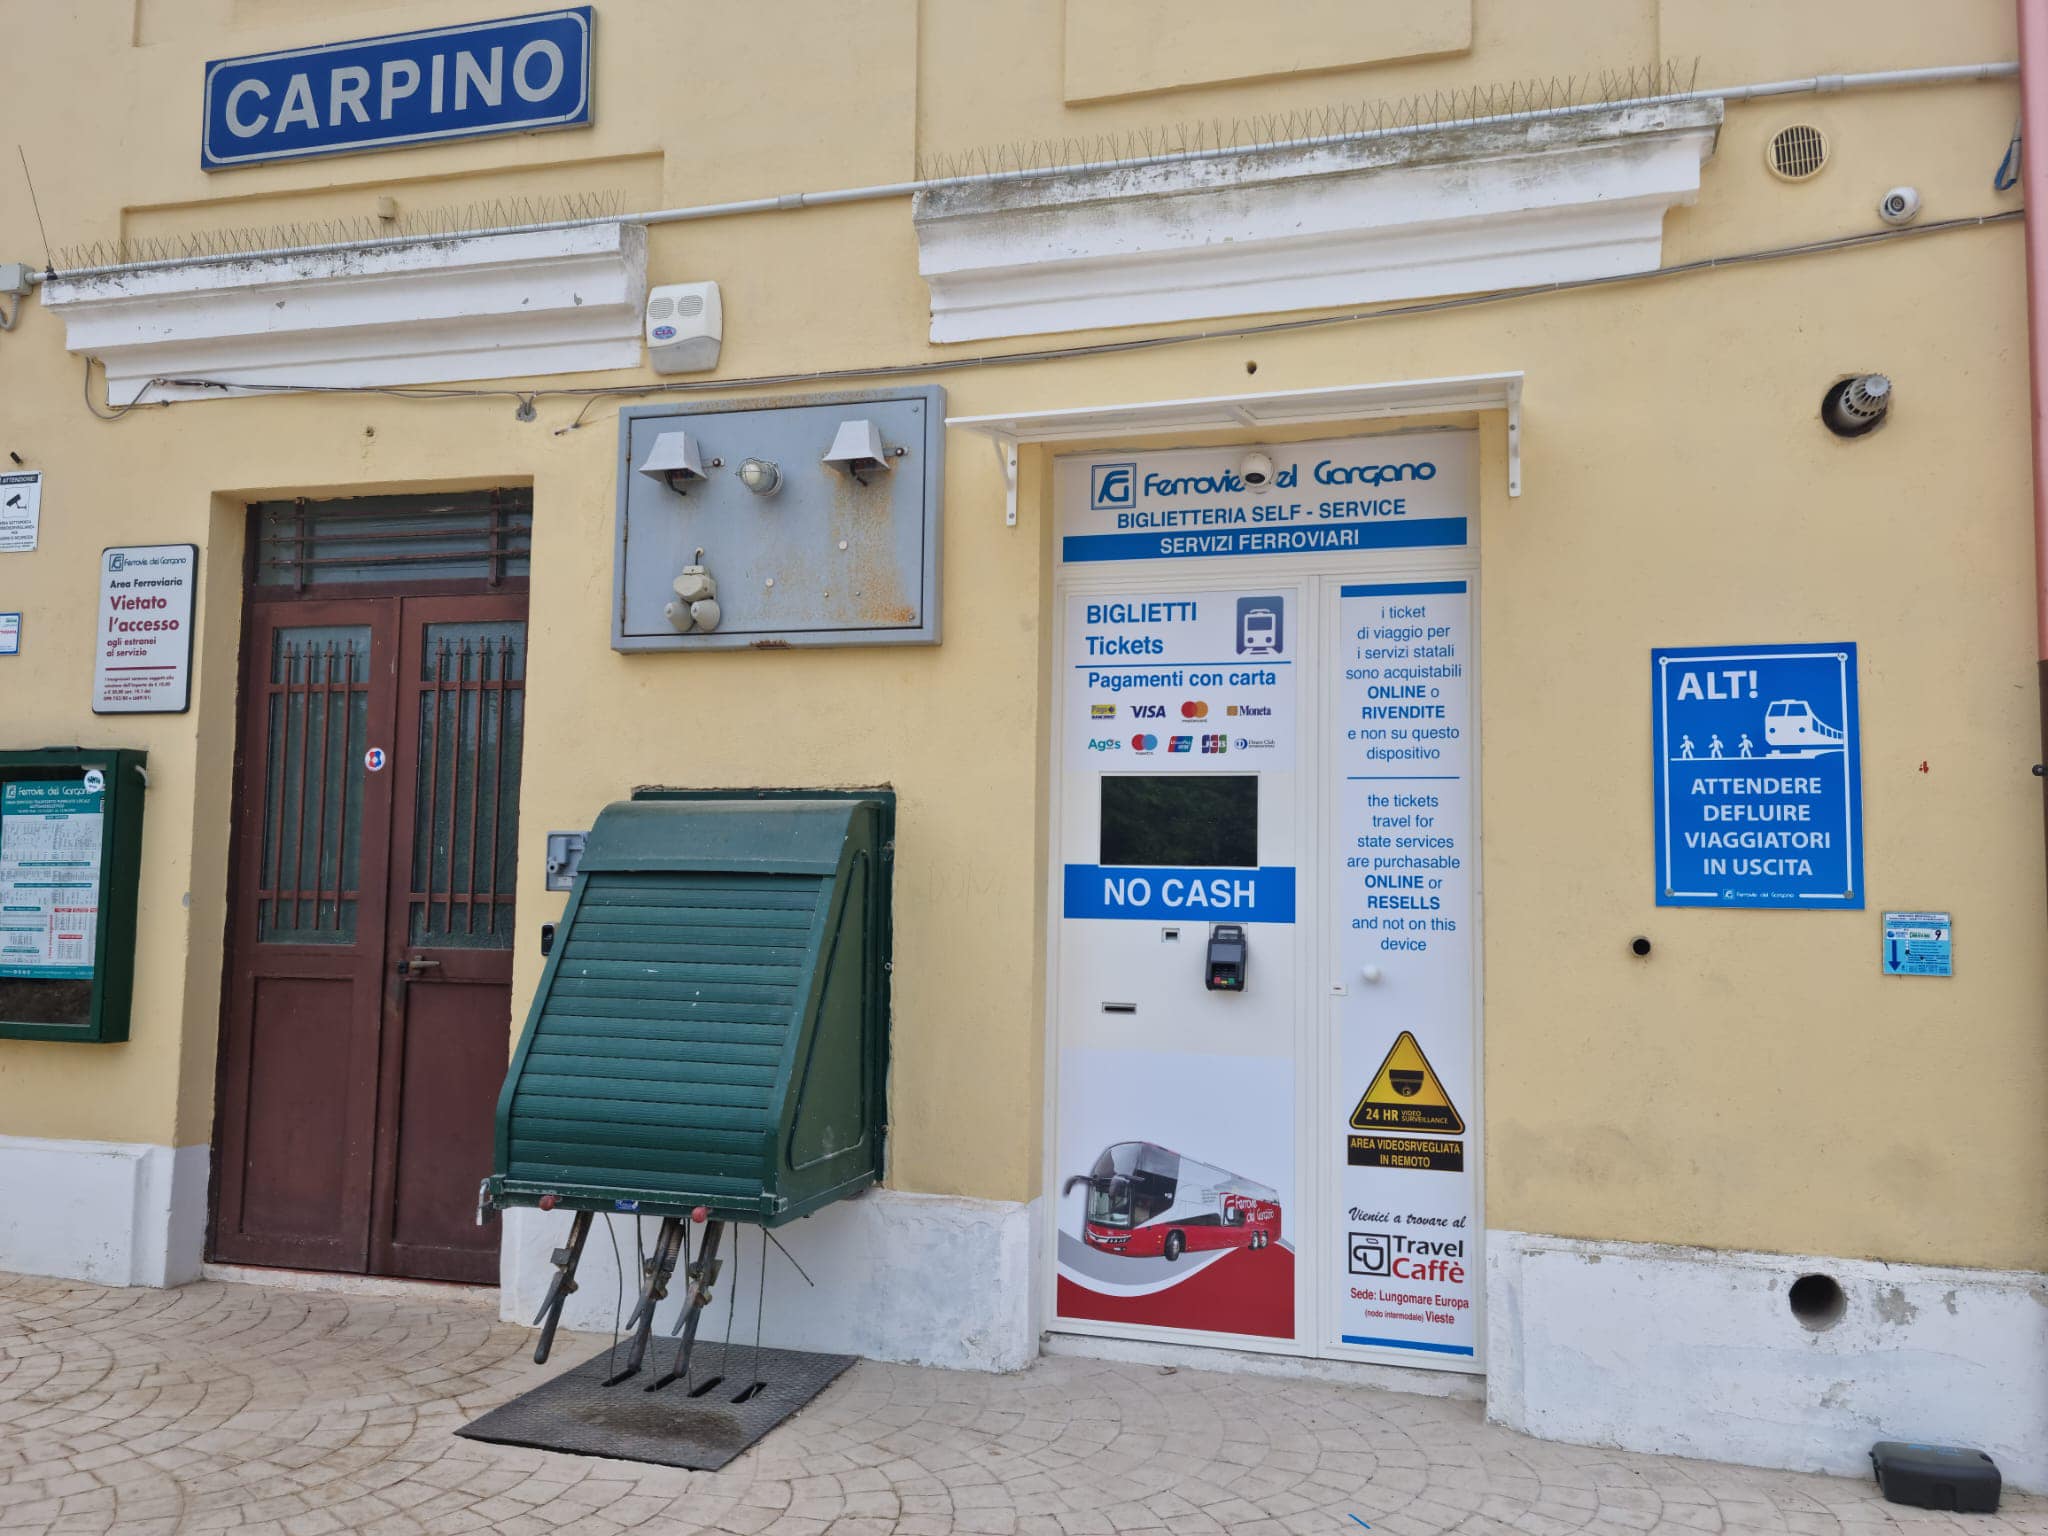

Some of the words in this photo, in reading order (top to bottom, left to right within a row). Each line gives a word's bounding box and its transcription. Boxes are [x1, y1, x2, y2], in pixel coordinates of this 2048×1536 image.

[226, 39, 564, 138] CARPINO
[1144, 469, 1245, 497] Ferrovie
[1314, 460, 1436, 488] Gargano
[1117, 507, 1247, 529] BIGLIETTERIA
[1252, 503, 1301, 523] SELF
[1319, 499, 1406, 519] SERVICE
[1160, 534, 1233, 555] SERVIZI
[1239, 529, 1360, 551] FERROVIARI
[110, 580, 131, 589] Area
[134, 577, 183, 587] Ferroviaria
[110, 595, 167, 611] Vietato
[1086, 602, 1197, 624] BIGLIETTI
[1389, 606, 1426, 618] ticket
[108, 616, 180, 633] l'accesso
[107, 637, 122, 648] agli
[124, 636, 157, 646] estranei
[1357, 627, 1369, 640] di
[1373, 626, 1423, 642] viaggio
[1427, 627, 1451, 639] per
[106, 648, 114, 657] al
[116, 647, 147, 657] servizio
[1085, 635, 1164, 655] Tickets
[1365, 646, 1409, 659] servizi
[1413, 644, 1455, 658] statali
[1346, 668, 1379, 680] sono
[1384, 664, 1462, 681] acquistabili
[1088, 671, 1183, 692] Pagamenti
[1189, 672, 1223, 687] con
[1229, 670, 1276, 686] carta
[1677, 670, 1759, 701] ALT!
[1367, 685, 1426, 699] ONLINE
[1430, 688, 1440, 698] o
[1129, 705, 1166, 719] VISA
[1239, 705, 1272, 717] Moneta
[1362, 705, 1446, 720] RIVENDITE
[1347, 729, 1357, 740] e
[1361, 728, 1386, 740] non
[1391, 728, 1407, 739] su
[1412, 726, 1460, 742] questo
[1366, 747, 1441, 762] dispositivo
[1691, 777, 1822, 795] ATTENDERE
[1367, 793, 1389, 807] the
[1394, 793, 1439, 808] tickets
[1704, 804, 1811, 822] DEFLUIRE
[1372, 815, 1411, 828] travel
[1415, 815, 1435, 828] for
[1357, 835, 1391, 848] state
[1396, 835, 1455, 848] services
[1684, 831, 1830, 849] VIAGGIATORI
[1347, 856, 1370, 868] are
[1374, 855, 1461, 870] purchasable
[1703, 859, 1726, 876] IN
[1733, 859, 1814, 876] USCITA
[1364, 874, 1424, 889] ONLINE
[1428, 878, 1443, 889] or
[1104, 878, 1151, 907] NO
[1161, 879, 1256, 909] CASH
[1367, 896, 1441, 910] RESELLS
[1352, 916, 1378, 929] and
[1382, 917, 1404, 930] not
[1408, 919, 1426, 930] on
[1431, 917, 1457, 932] this
[1380, 937, 1427, 951] device
[1365, 1108, 1379, 1120] 24
[1383, 1109, 1399, 1121] HR
[1350, 1137, 1375, 1149] AREA
[1377, 1139, 1461, 1154] VIDEOSRVEGLIATA
[1380, 1154, 1389, 1165] IN
[1391, 1155, 1431, 1168] REMOTO
[1348, 1207, 1390, 1222] Vienici
[1394, 1214, 1402, 1223] a
[1406, 1214, 1448, 1227] trovare
[1452, 1215, 1467, 1228] al
[1392, 1235, 1464, 1258] Travel
[1392, 1257, 1465, 1284] Caffè
[1350, 1287, 1377, 1300] Sede:
[1379, 1289, 1433, 1306] Lungomare
[1435, 1294, 1469, 1310] Europa
[1364, 1308, 1384, 1318] (nodo
[1384, 1310, 1424, 1323] intermodale)
[1425, 1310, 1455, 1324] Vieste
